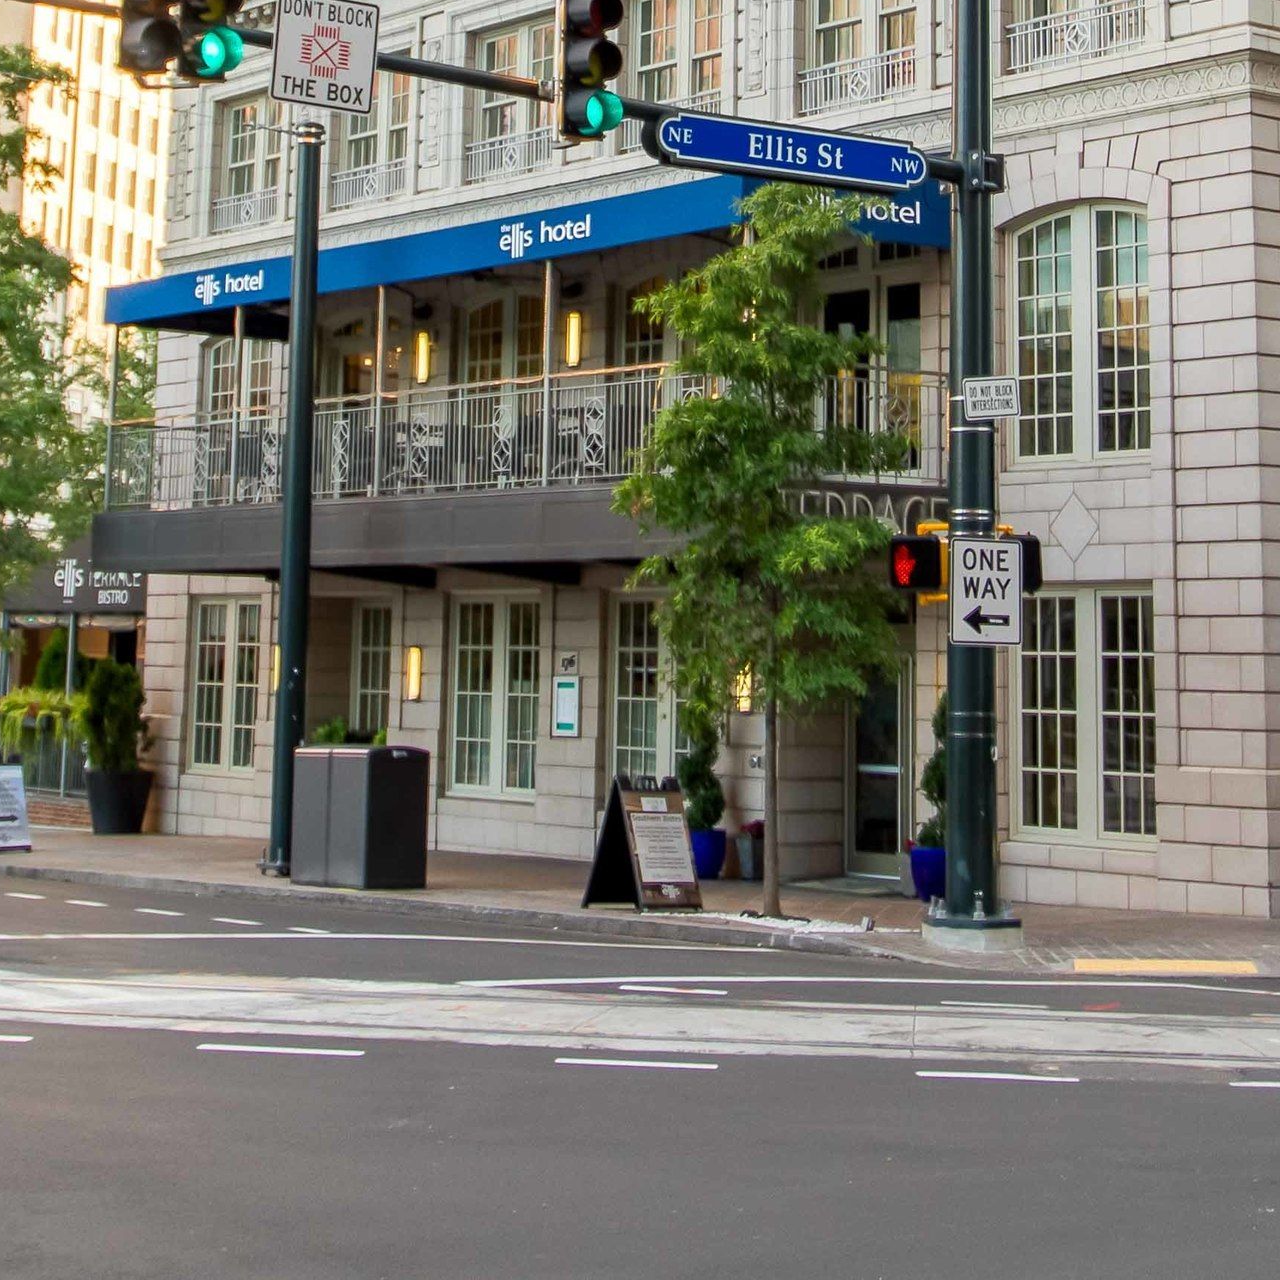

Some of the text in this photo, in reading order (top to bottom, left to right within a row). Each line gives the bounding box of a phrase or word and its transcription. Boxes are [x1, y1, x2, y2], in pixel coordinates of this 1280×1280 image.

[328, 4, 374, 29] BLOCK
[281, 75, 364, 106] THE BOX
[667, 126, 693, 144] NE
[748, 132, 844, 170] Ellis St
[890, 156, 919, 175] NW
[499, 213, 591, 259] ellis hotel
[195, 269, 264, 306] ellis hotel
[980, 385, 991, 397] NOT
[994, 384, 1013, 397] BLOCK
[970, 398, 1014, 412] INTERSECTIONS
[962, 547, 1010, 572] ONE
[963, 576, 1011, 600] WAY
